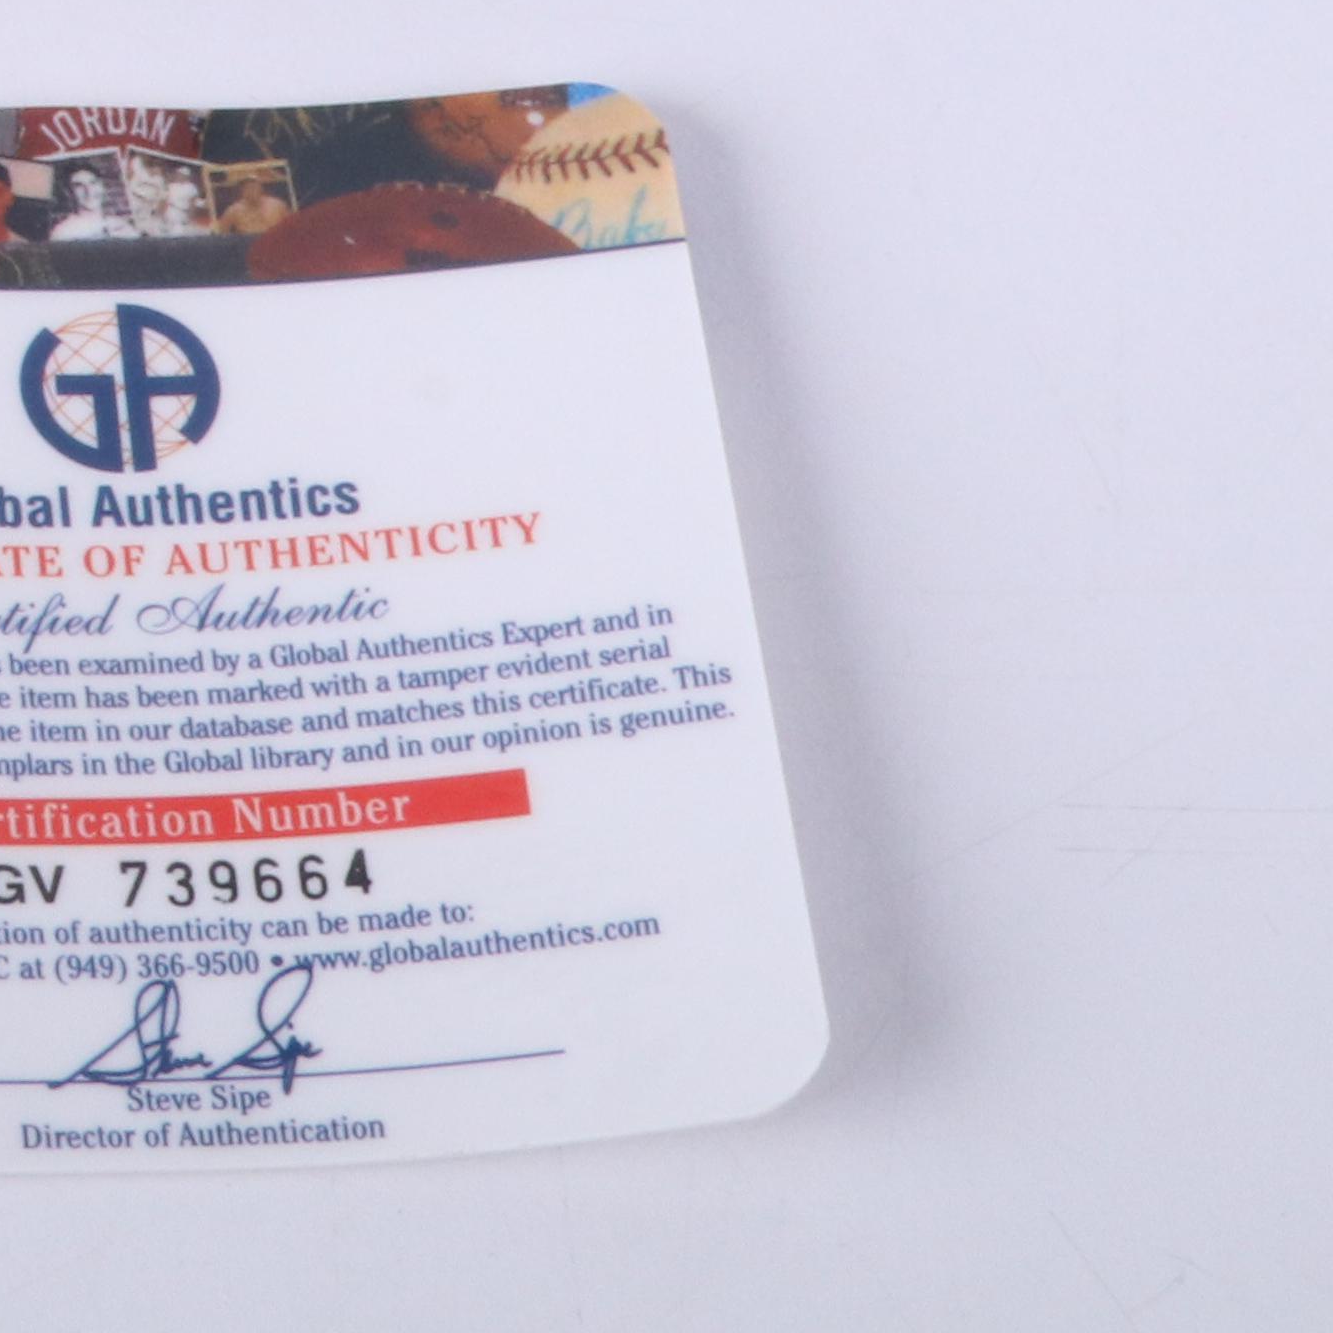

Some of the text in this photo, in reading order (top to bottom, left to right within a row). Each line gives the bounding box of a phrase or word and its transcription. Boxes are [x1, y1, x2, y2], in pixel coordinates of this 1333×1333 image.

[40, 107, 175, 153] JORDAN
[92, 476, 361, 528] Authentics
[83, 544, 145, 578] OF
[165, 511, 541, 576] AUTHENTICITY
[136, 582, 389, 634] Authentic
[9, 653, 70, 675] been
[79, 651, 204, 675] examined
[213, 650, 240, 676] by
[248, 650, 262, 668] a
[270, 641, 348, 667] Global
[356, 627, 493, 661] Authentics
[502, 615, 585, 648] Expert
[593, 606, 639, 635] and
[648, 604, 673, 627] in
[20, 688, 76, 709] item
[86, 686, 130, 708] has
[138, 685, 197, 707] been
[208, 679, 303, 704] marked
[310, 672, 367, 698] with
[376, 671, 391, 693] a
[399, 663, 489, 691] tamper
[497, 647, 591, 679] evident
[599, 635, 670, 667] serial
[30, 721, 87, 742] item
[96, 720, 121, 742] in
[130, 722, 171, 740] our
[180, 715, 291, 740] database
[302, 707, 348, 731] and
[356, 697, 464, 729] matches
[473, 690, 521, 715] this
[530, 675, 667, 710] certificate.
[673, 662, 731, 689] This
[83, 754, 106, 775] in
[115, 753, 155, 775] the
[165, 749, 241, 774] Global
[251, 743, 334, 771] library
[343, 738, 389, 763] and
[398, 735, 423, 758] in
[432, 732, 474, 755] our
[483, 717, 581, 753] opinion
[591, 713, 611, 735] is
[620, 700, 734, 737] genuine.
[232, 792, 411, 834] Number
[20, 957, 45, 980] at
[54, 955, 127, 983] (949)
[138, 951, 259, 978] 366-9500
[295, 914, 661, 972] www.globalauthentics.com
[54, 921, 83, 944] of
[89, 909, 252, 946] authenticity
[262, 913, 309, 938] can
[317, 911, 349, 934] be
[359, 903, 432, 932] made
[441, 901, 475, 924] to:
[128, 1085, 271, 1115] Steve Sipe
[22, 1116, 385, 1149] Director of Authentication
